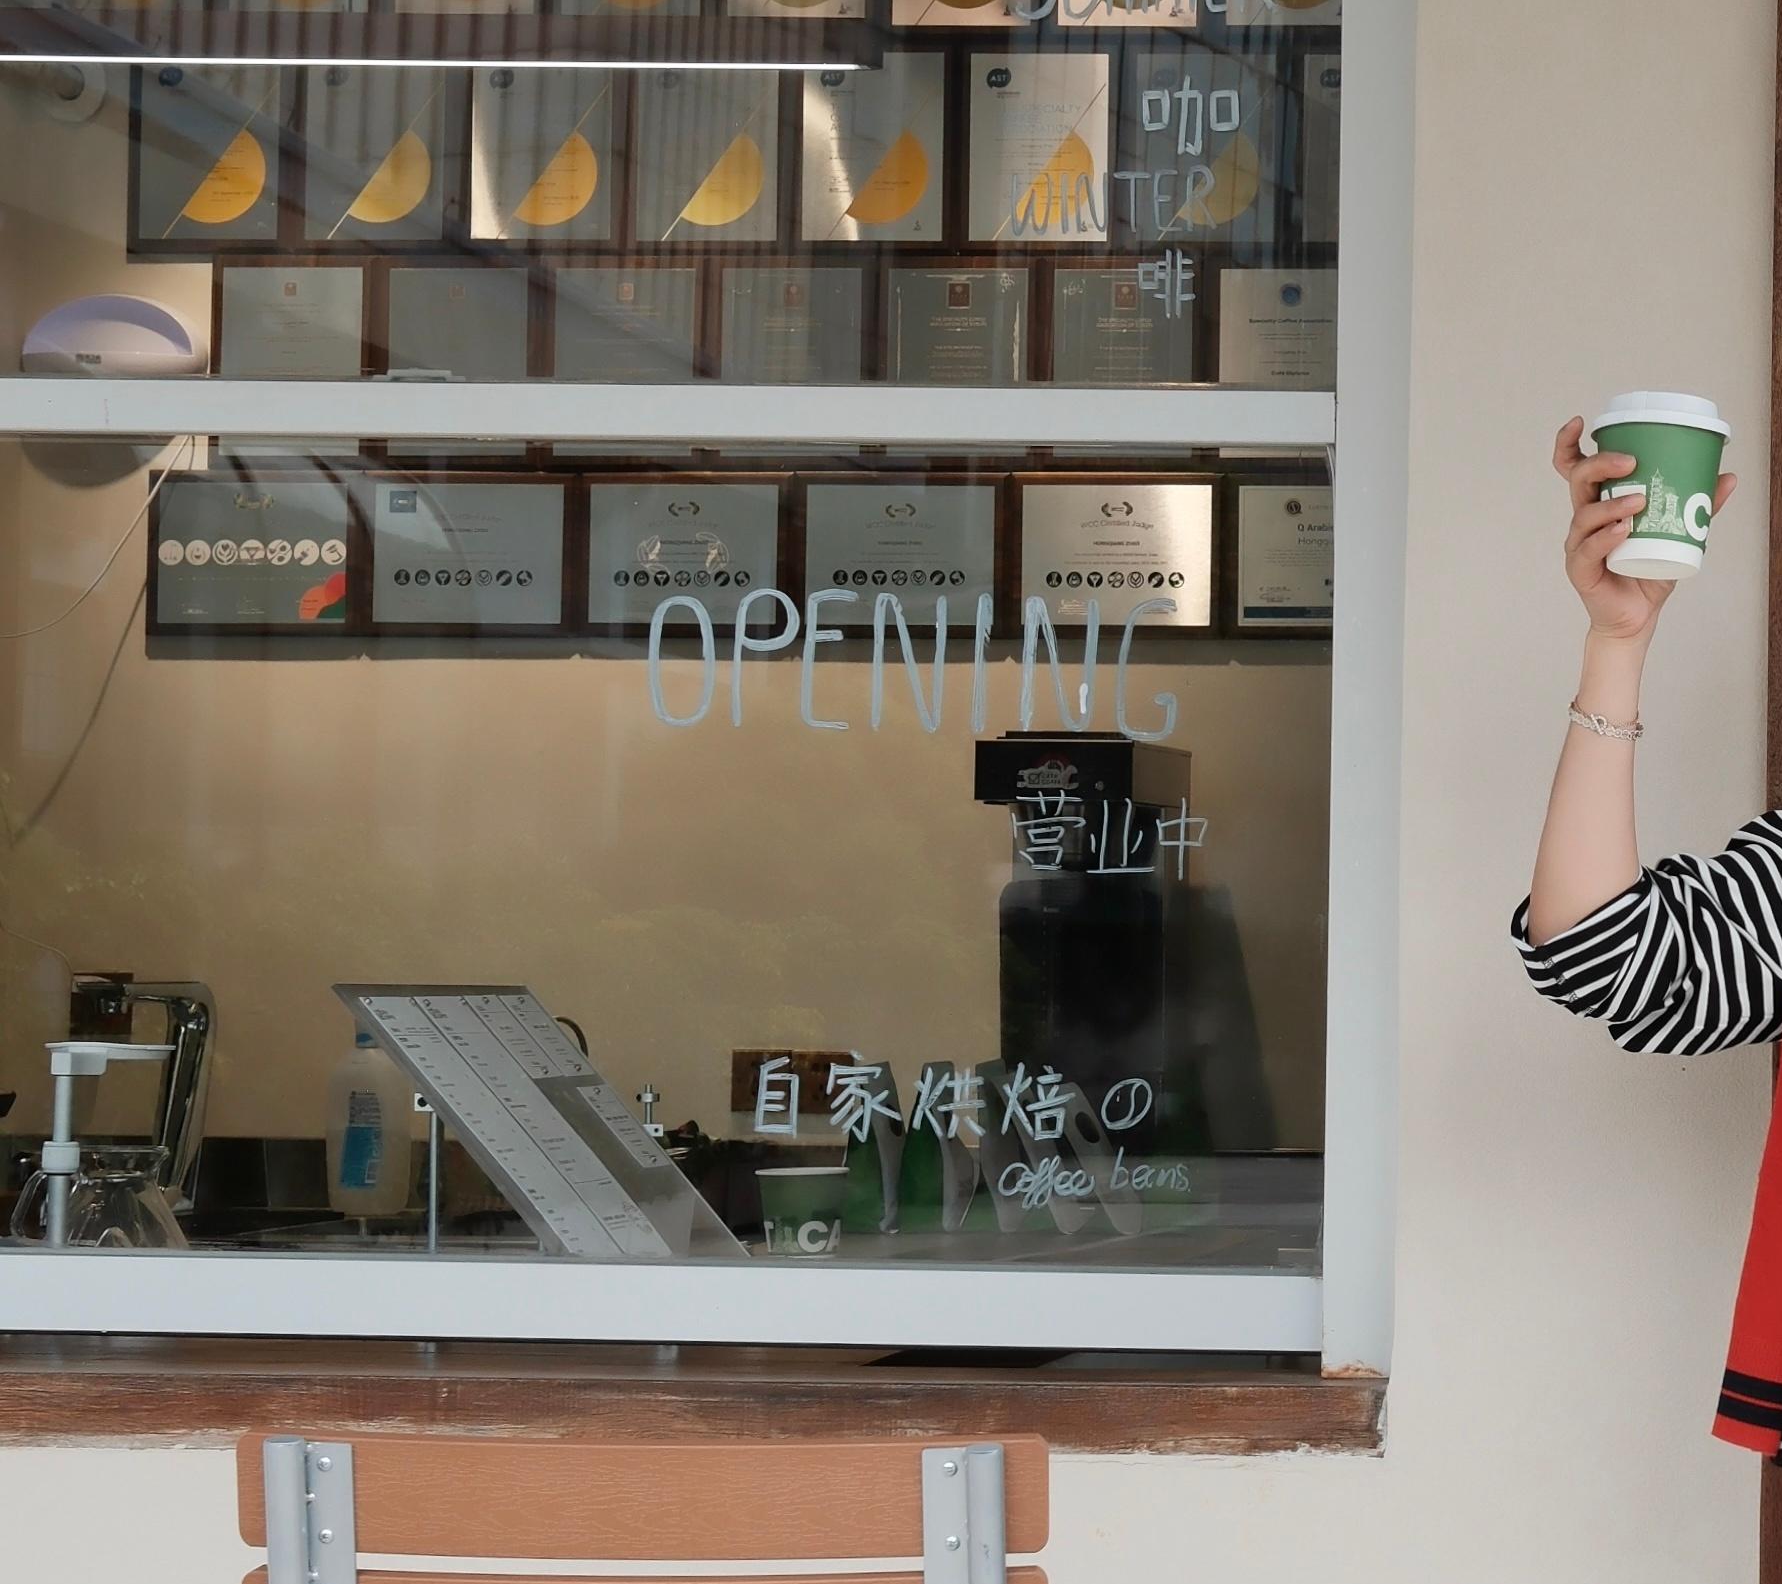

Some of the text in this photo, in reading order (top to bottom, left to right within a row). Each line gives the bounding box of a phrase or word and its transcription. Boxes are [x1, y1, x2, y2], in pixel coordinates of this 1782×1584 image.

[1142, 74, 1240, 156] 咖
[1011, 165, 1217, 237] WINTER
[1137, 249, 1195, 319] 啡
[647, 588, 1178, 740] OPENING
[1012, 789, 1208, 881] 营业中
